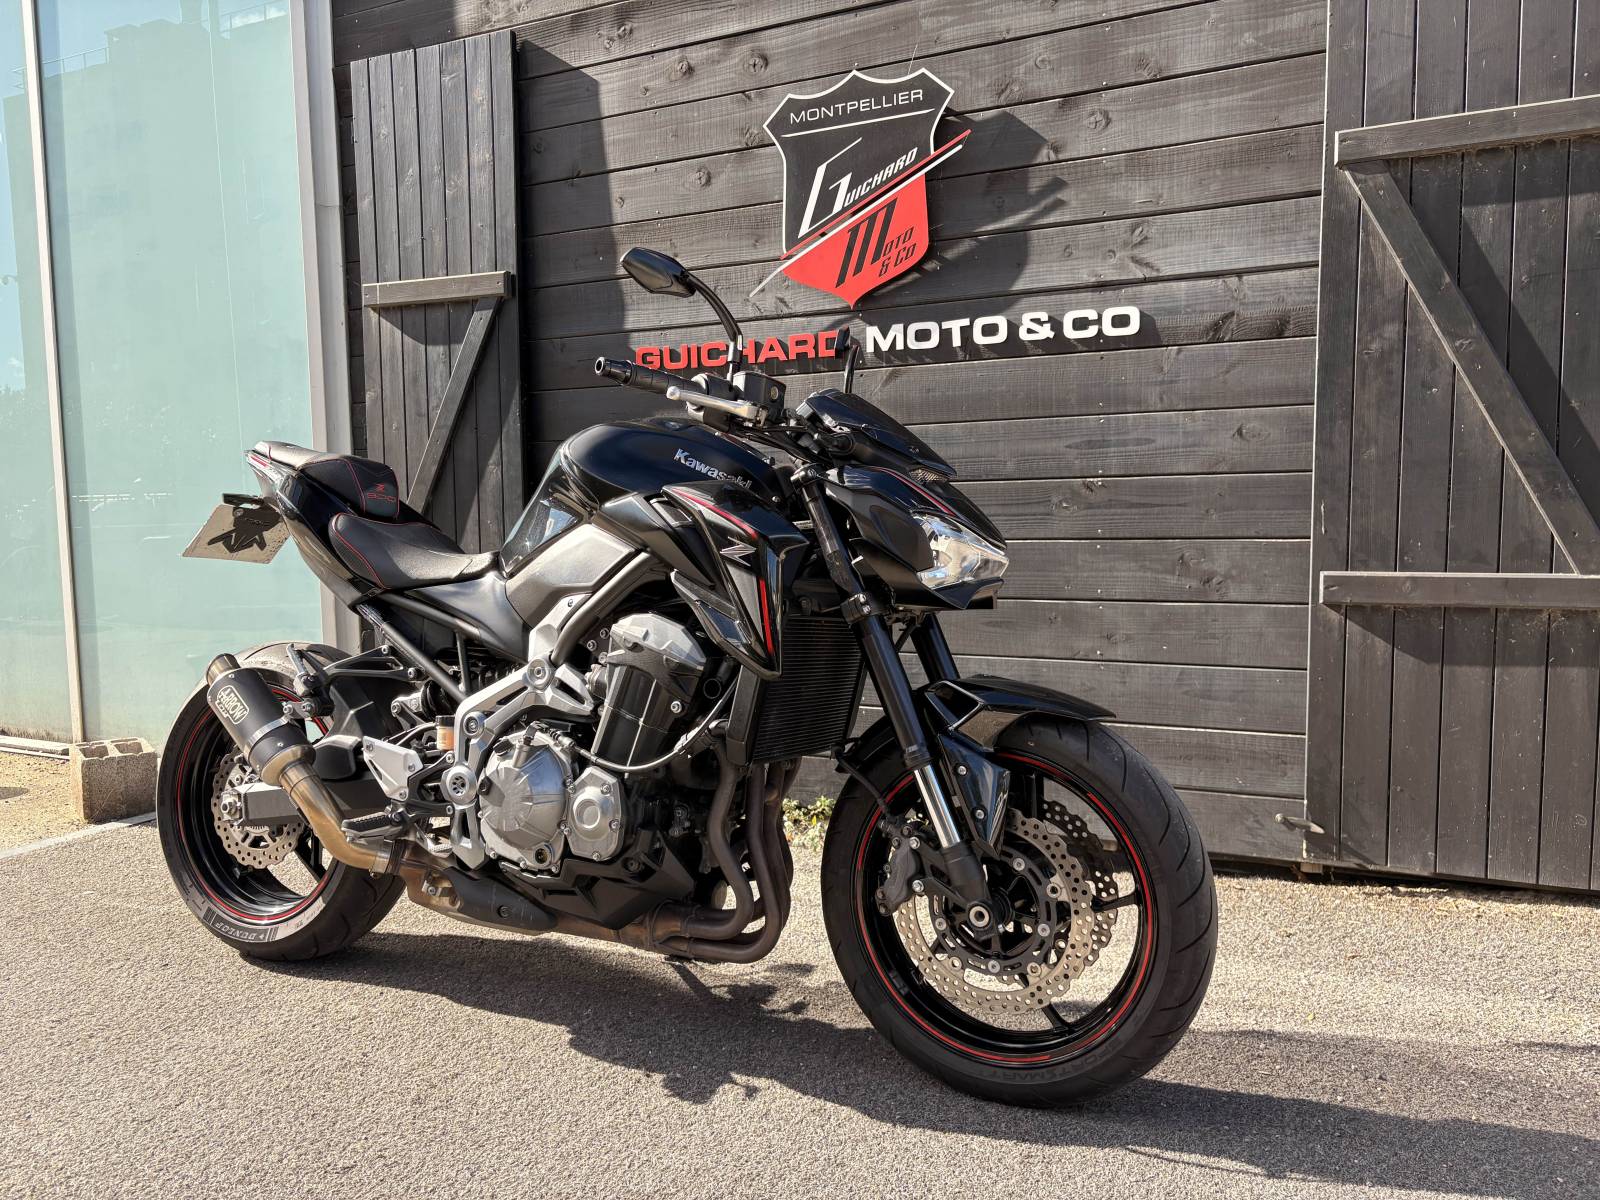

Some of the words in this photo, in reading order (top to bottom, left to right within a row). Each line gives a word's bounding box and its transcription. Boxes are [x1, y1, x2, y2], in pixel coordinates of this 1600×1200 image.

[790, 89, 923, 124] MONTPELLIER
[798, 137, 918, 239] GUICHARD
[866, 315, 1008, 352] MOTO
[1018, 311, 1055, 341] &
[1063, 305, 1141, 340] CO
[215, 922, 257, 940] DUNLOP
